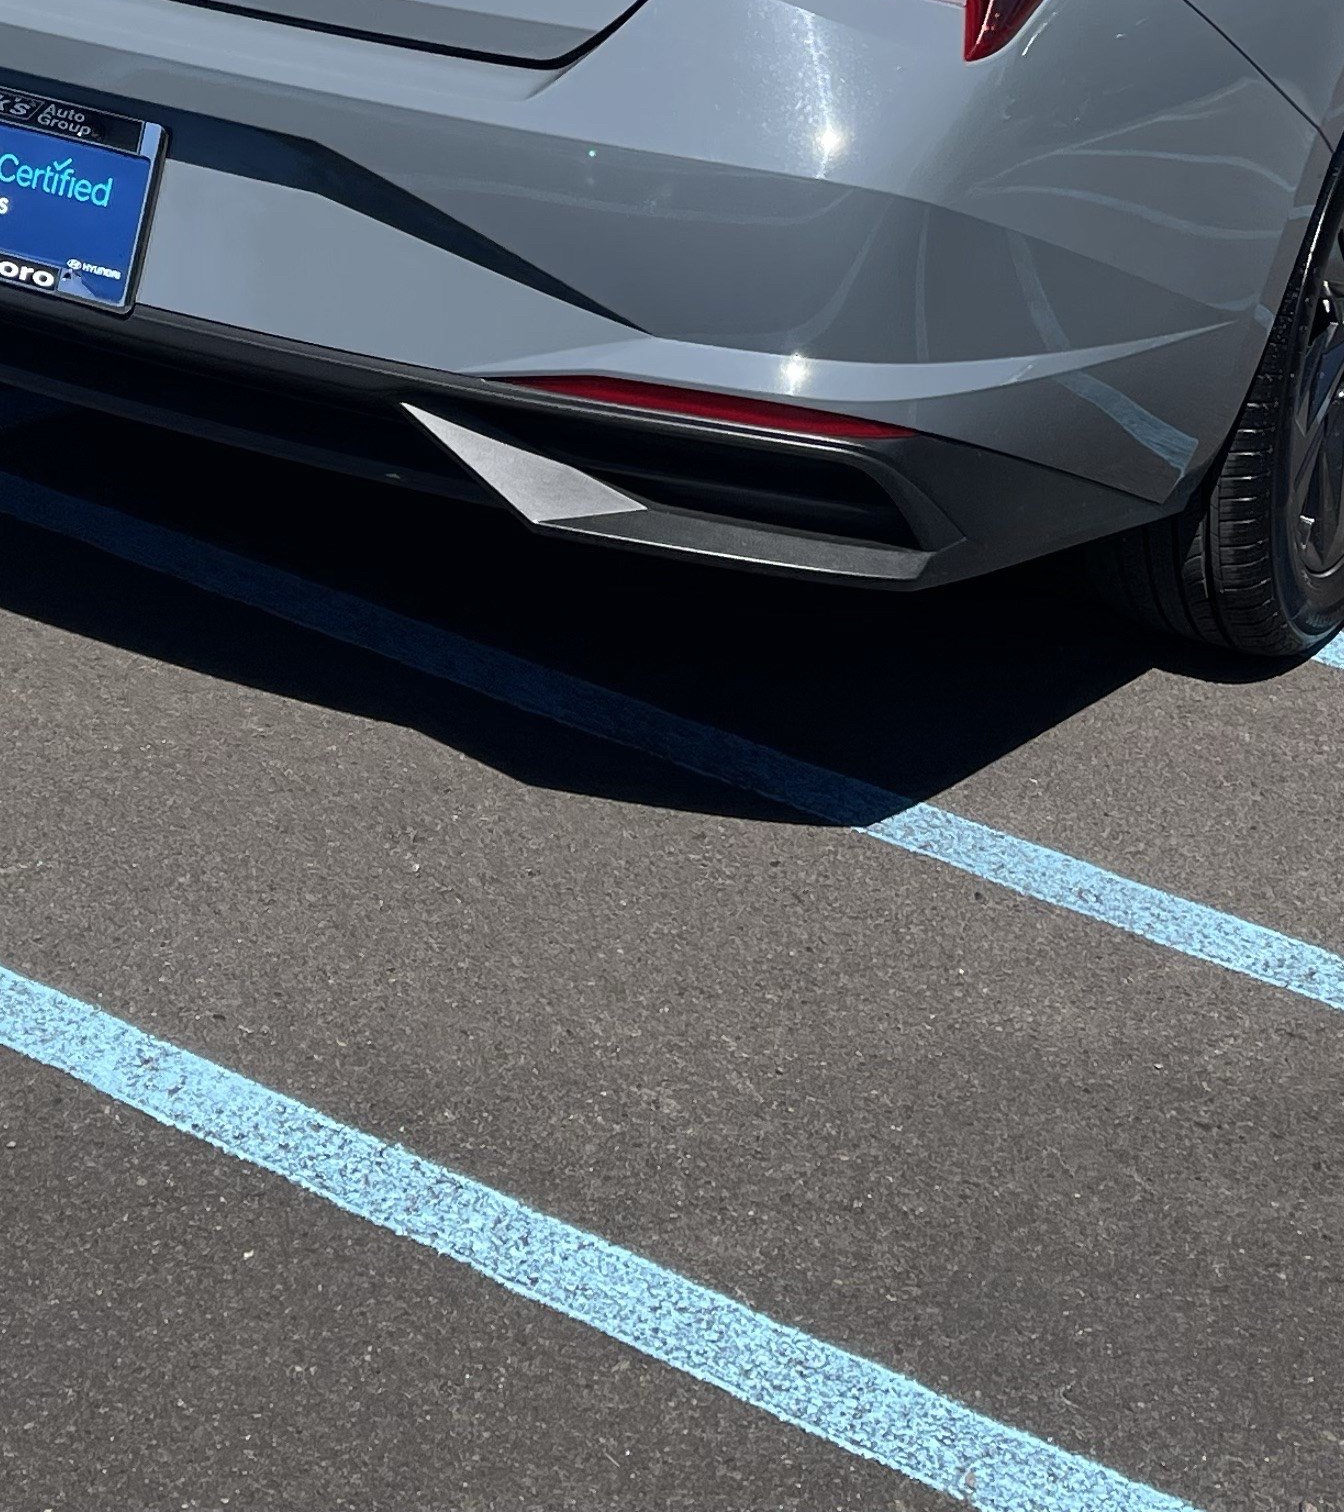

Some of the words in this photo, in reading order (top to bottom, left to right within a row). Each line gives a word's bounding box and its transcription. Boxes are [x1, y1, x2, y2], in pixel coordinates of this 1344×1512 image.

[42, 103, 86, 123] Auto
[37, 113, 92, 137] Group
[82, 262, 122, 280] HYUNDAI
